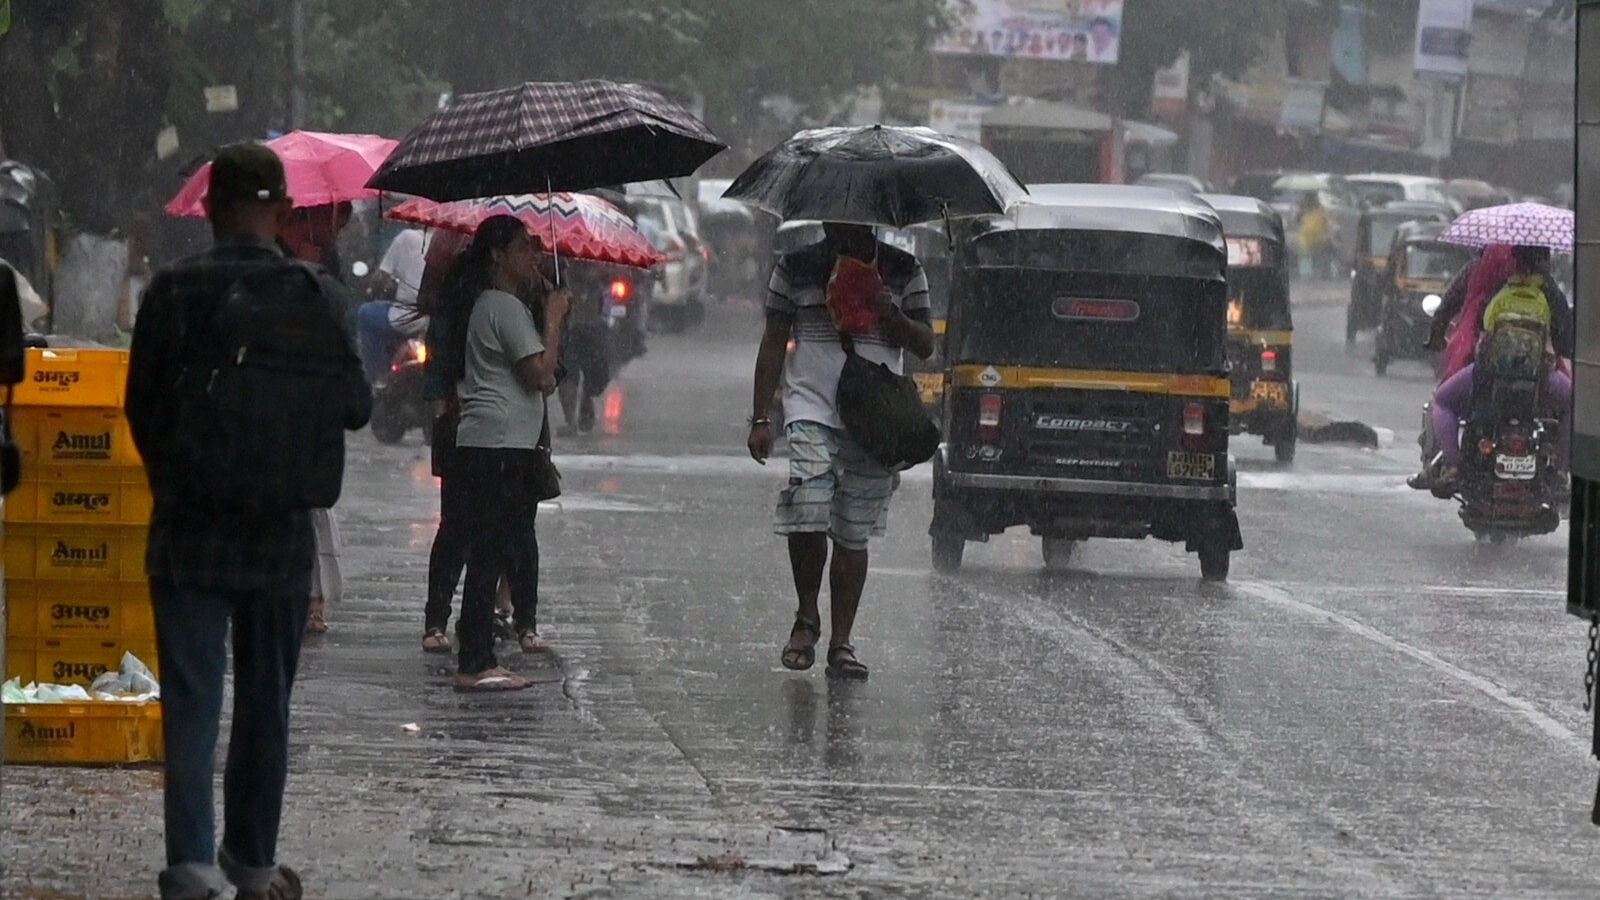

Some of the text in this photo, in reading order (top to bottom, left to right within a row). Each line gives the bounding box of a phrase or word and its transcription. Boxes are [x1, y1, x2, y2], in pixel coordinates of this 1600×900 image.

[52, 431, 111, 450] Amul
[52, 541, 108, 560] Amul
[18, 720, 75, 740] Amul
